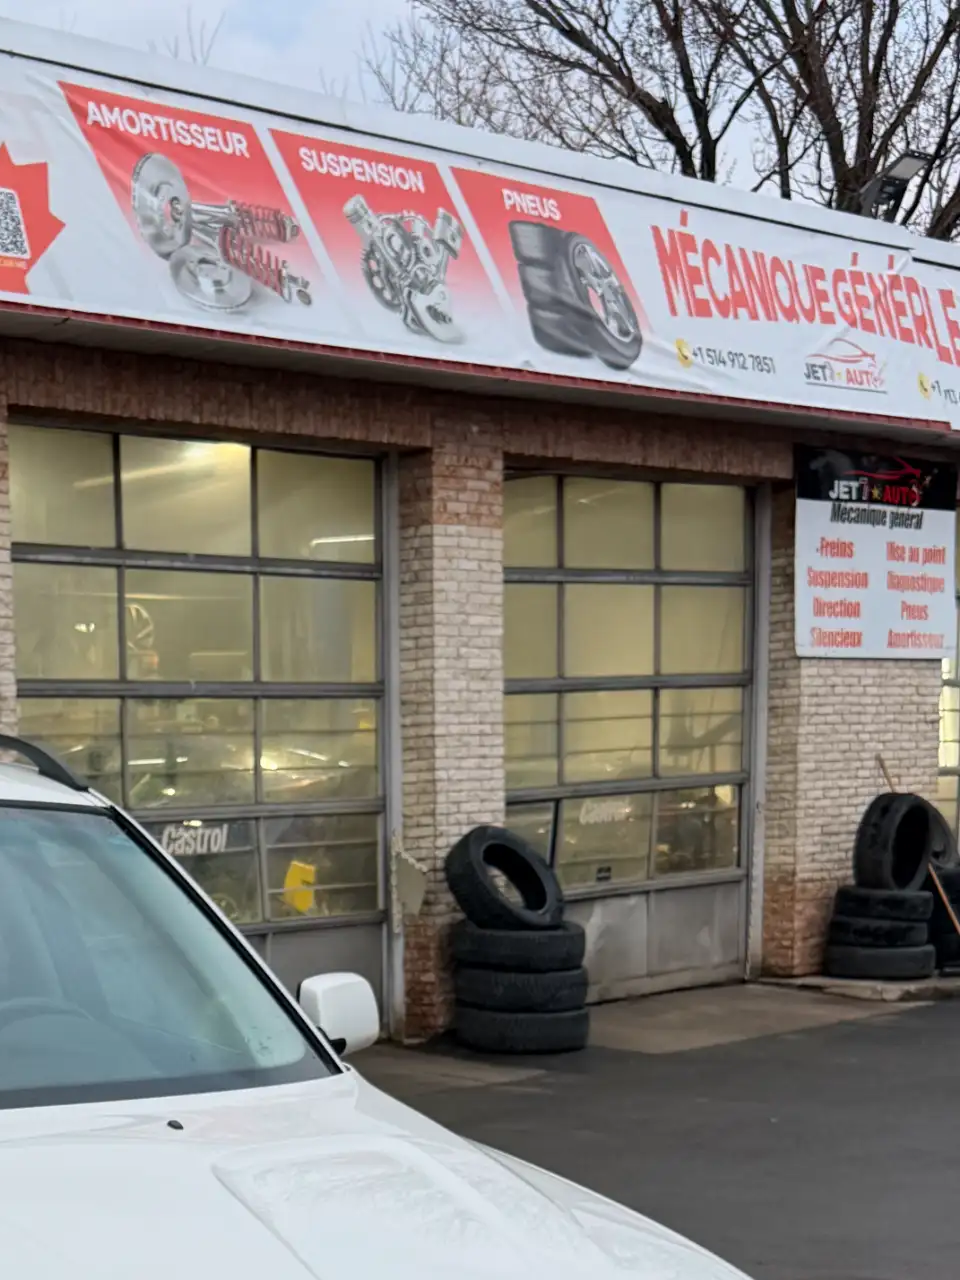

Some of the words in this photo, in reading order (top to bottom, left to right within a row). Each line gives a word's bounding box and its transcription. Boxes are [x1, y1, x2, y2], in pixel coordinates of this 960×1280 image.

[86, 100, 251, 159] AMORTISSEUR
[298, 146, 425, 194] SUSPENSION
[501, 188, 562, 222] PNEUS
[807, 566, 869, 590] Suspension
[162, 823, 228, 856] Castrol
